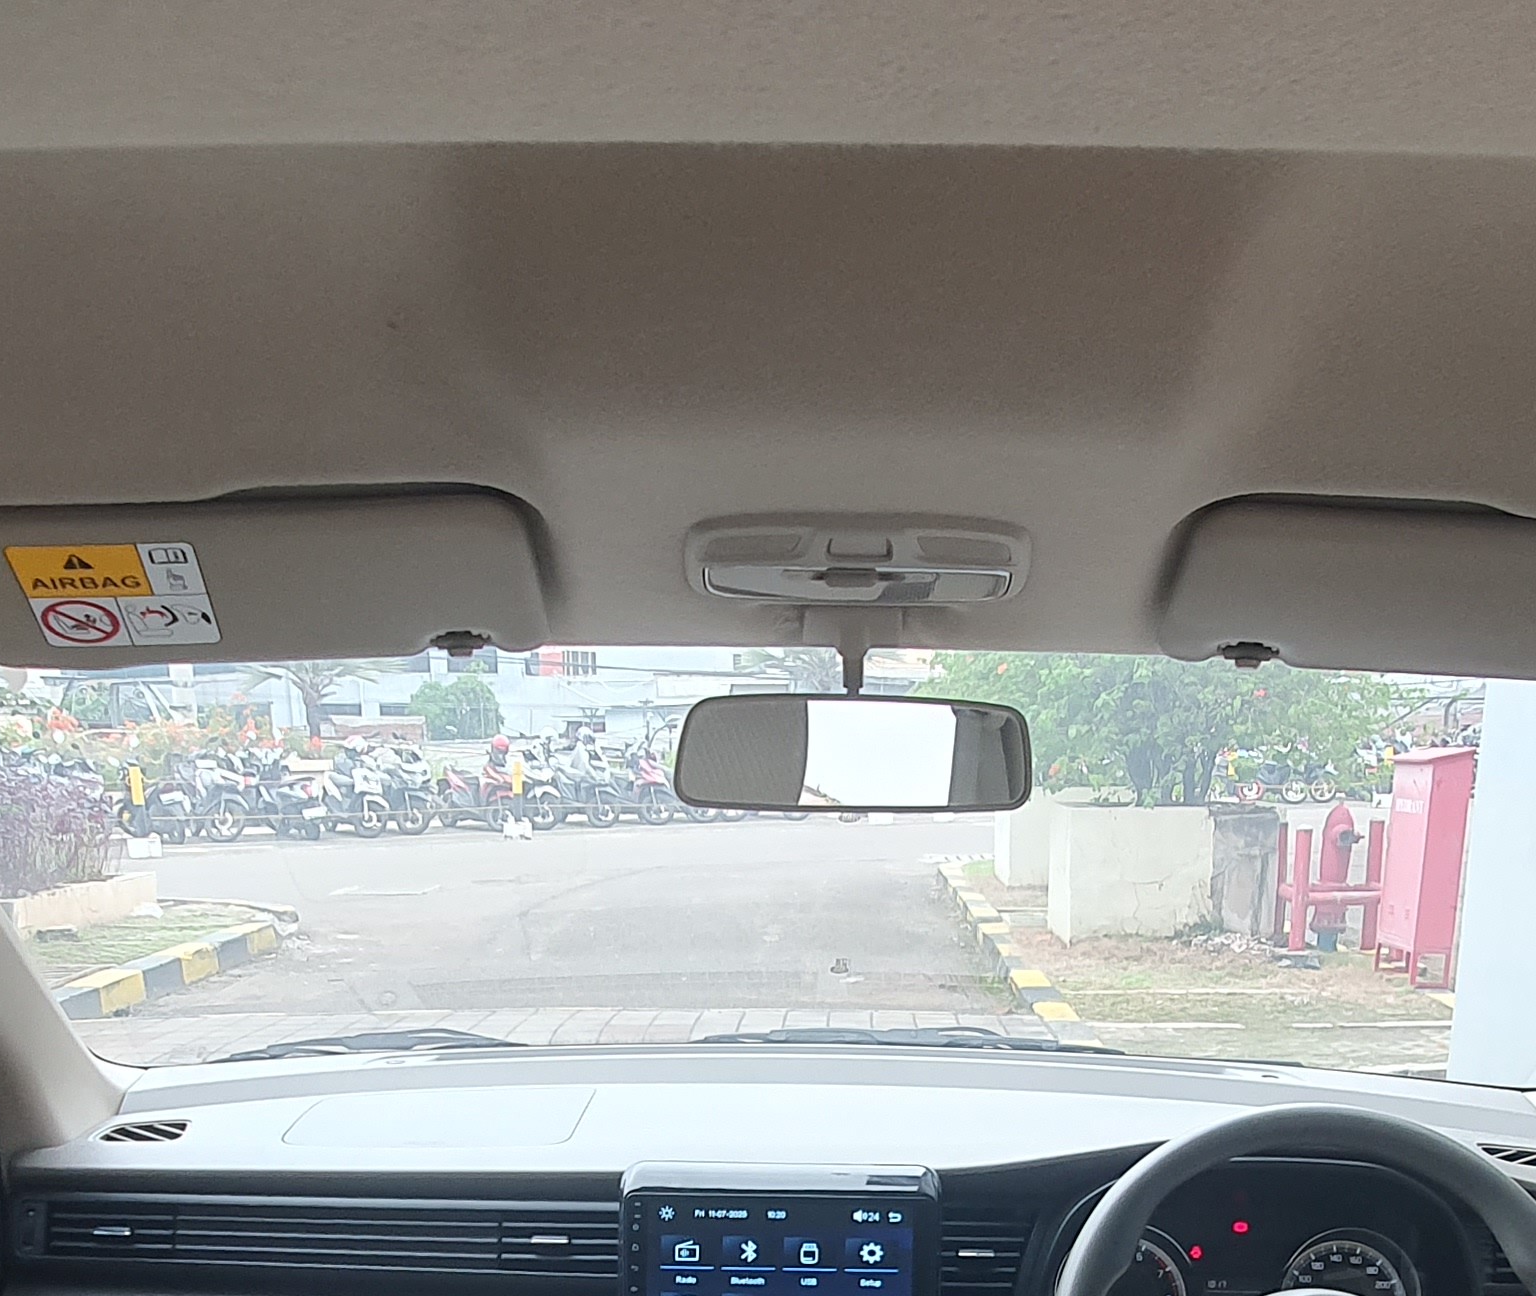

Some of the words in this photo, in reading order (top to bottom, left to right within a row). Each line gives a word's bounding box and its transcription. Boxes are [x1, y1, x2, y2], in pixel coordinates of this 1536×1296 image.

[31, 575, 142, 591] AIRBAG
[694, 1209, 705, 1219] Fri
[867, 1212, 880, 1222] 24
[1135, 1252, 1143, 1261] 6
[1157, 1269, 1164, 1278] 7
[675, 1276, 697, 1284] Radio
[800, 1278, 818, 1286] USB
[859, 1279, 882, 1288] Setup
[1298, 1275, 1312, 1283] 100
[1375, 1281, 1391, 1289] 200
